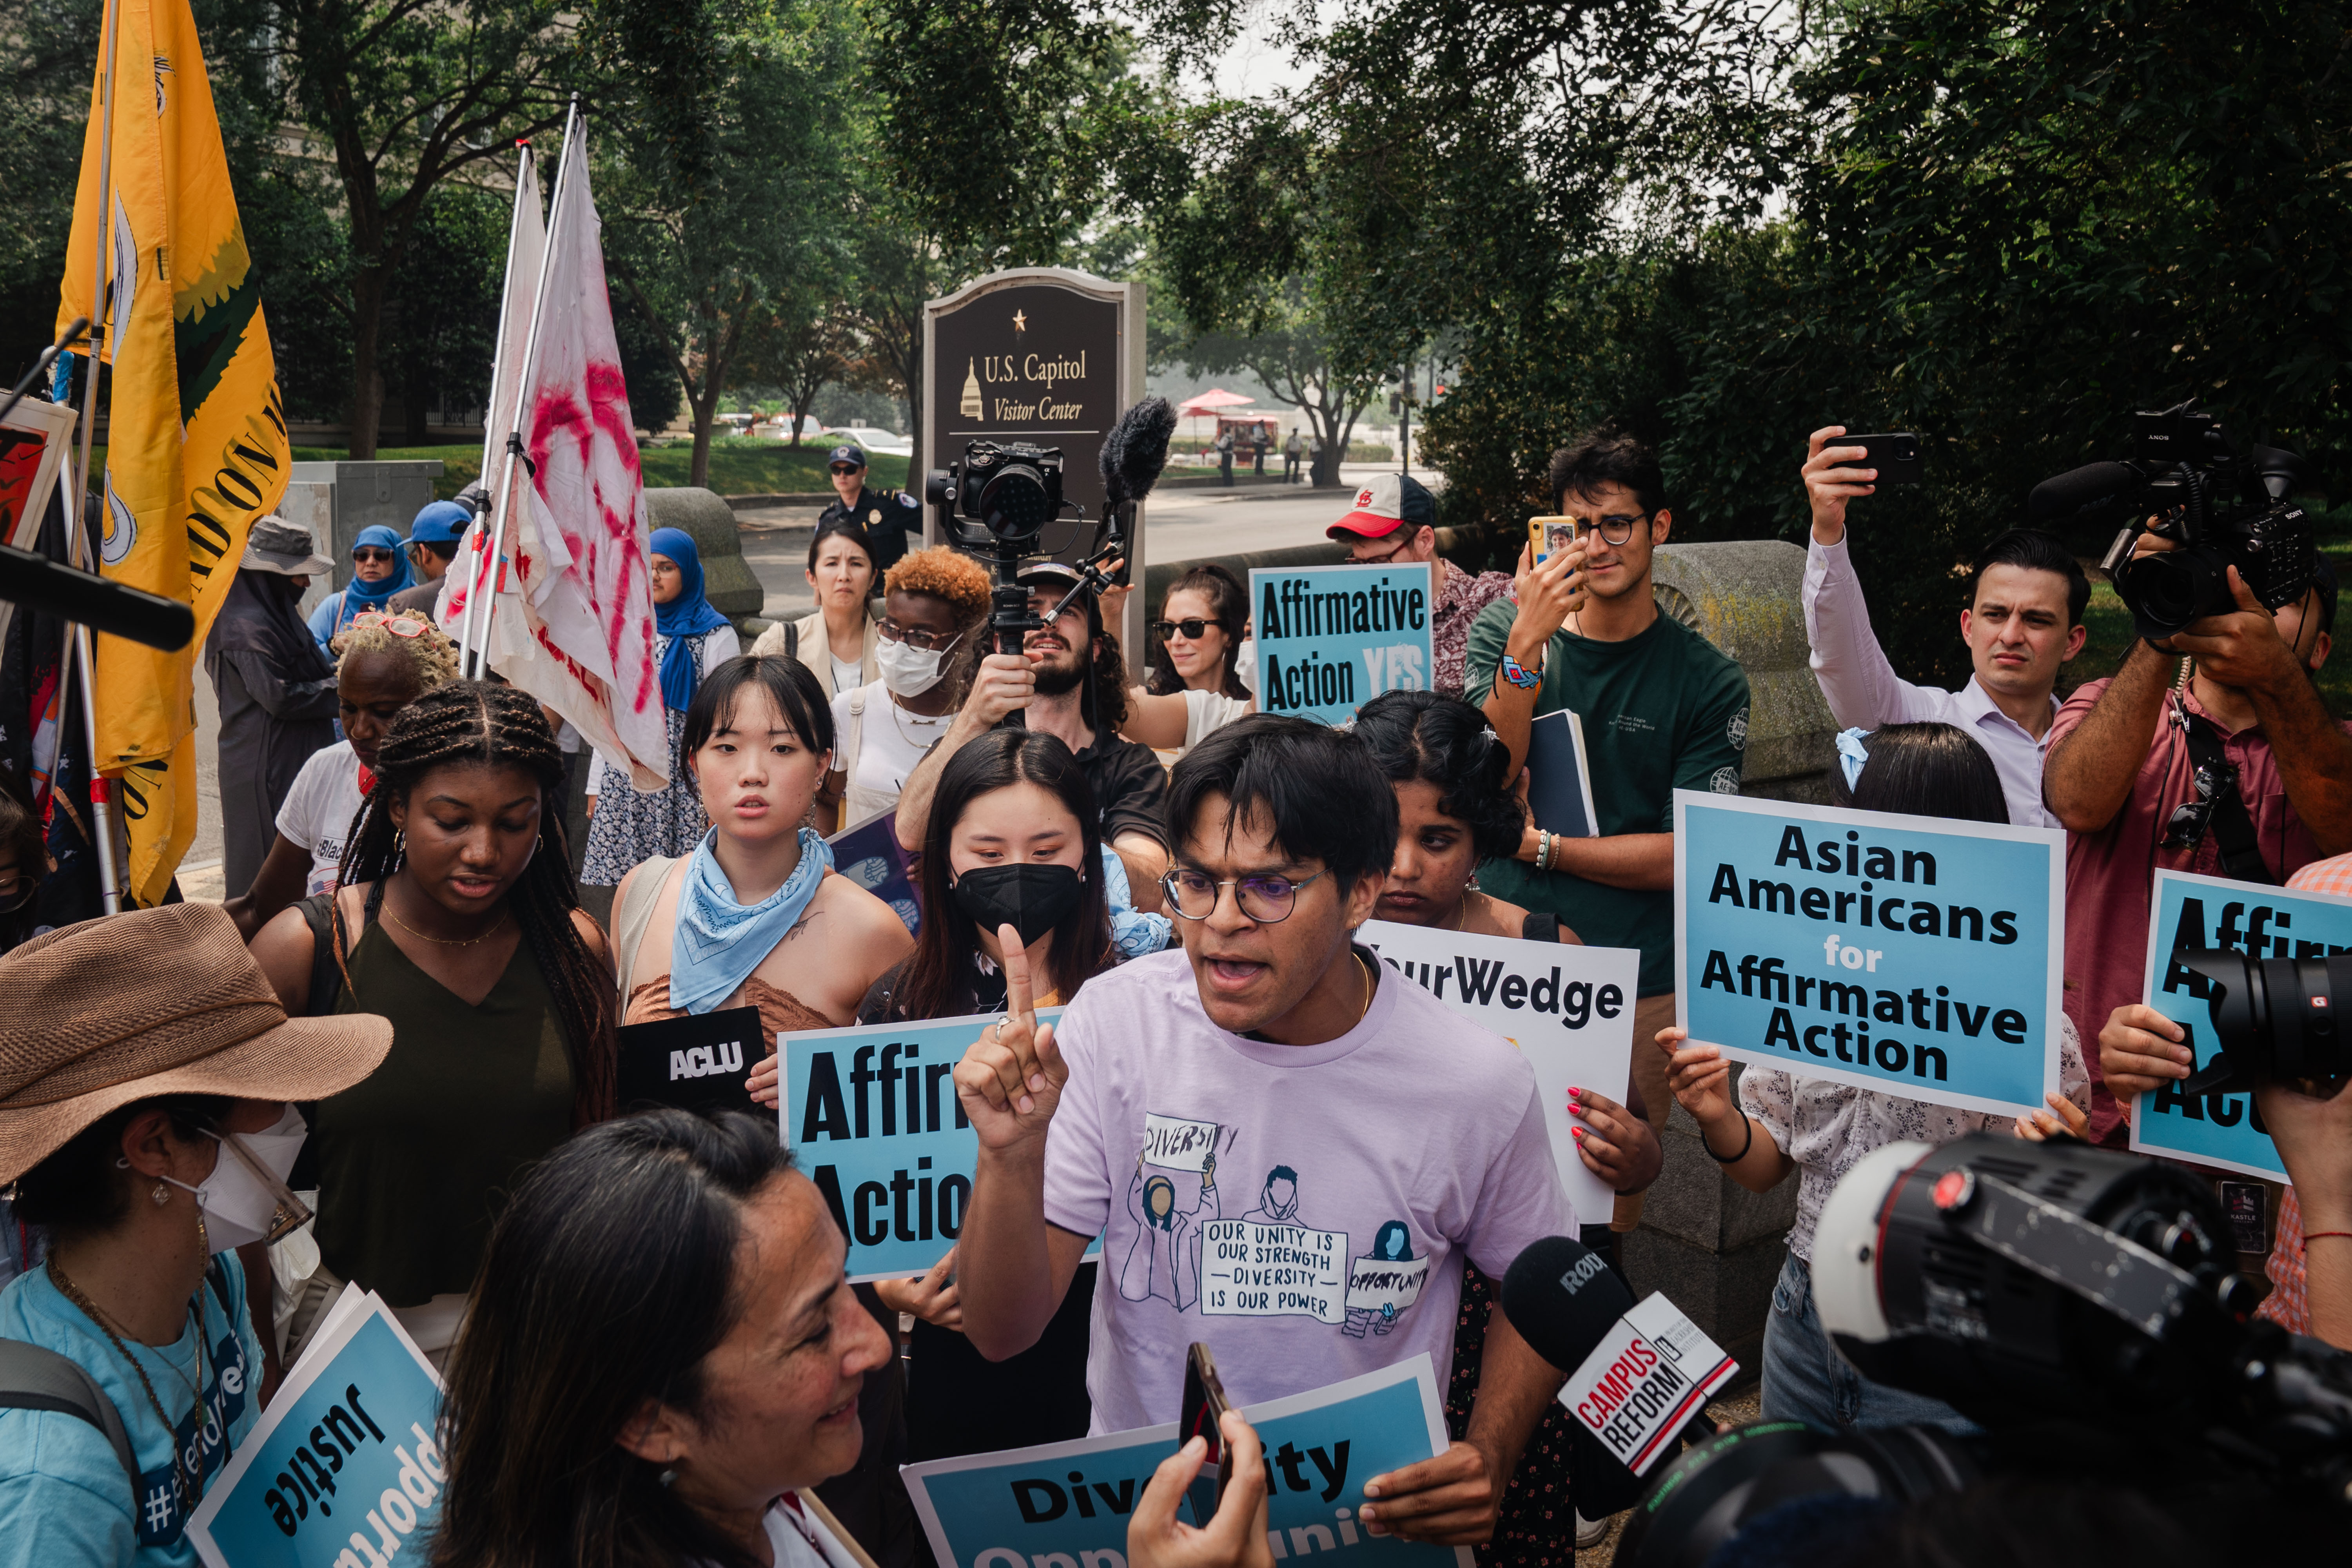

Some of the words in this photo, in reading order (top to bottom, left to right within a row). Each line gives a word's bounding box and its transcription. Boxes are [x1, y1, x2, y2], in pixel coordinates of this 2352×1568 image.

[985, 355, 1018, 383] U.S.
[1024, 350, 1086, 389] Capitol
[995, 398, 1035, 421] Visitor
[1039, 396, 1082, 420] Center
[2285, 509, 2303, 520] SONY
[1262, 577, 1424, 640] Affirmative
[1267, 651, 1354, 711] Action
[1363, 643, 1425, 699] YES
[1774, 825, 1937, 886] Asian
[1708, 863, 2018, 945] Americans
[1824, 935, 1882, 973] for
[1700, 950, 2027, 1044] Affirmative
[670, 1041, 743, 1081] ACLU
[1764, 1007, 1948, 1081] Action
[801, 1042, 970, 1143] Affir
[1145, 1123, 1239, 1159] DIVERSITY
[813, 1156, 973, 1247] Actio
[1209, 1224, 1245, 1241] OUR
[1256, 1227, 1306, 1247] UNITY
[1317, 1233, 1333, 1251] IS
[1218, 1243, 1248, 1262] OUR
[1256, 1247, 1330, 1270] STRENGTH
[1211, 1291, 1225, 1307] IS
[1237, 1292, 1269, 1310] OUR
[1278, 1292, 1328, 1316] POWER
[1234, 1267, 1316, 1288] DIVERSITY
[1577, 1338, 1657, 1429] CAMPUS
[1602, 1361, 1684, 1454] REFORM
[264, 1383, 386, 1537] Justice
